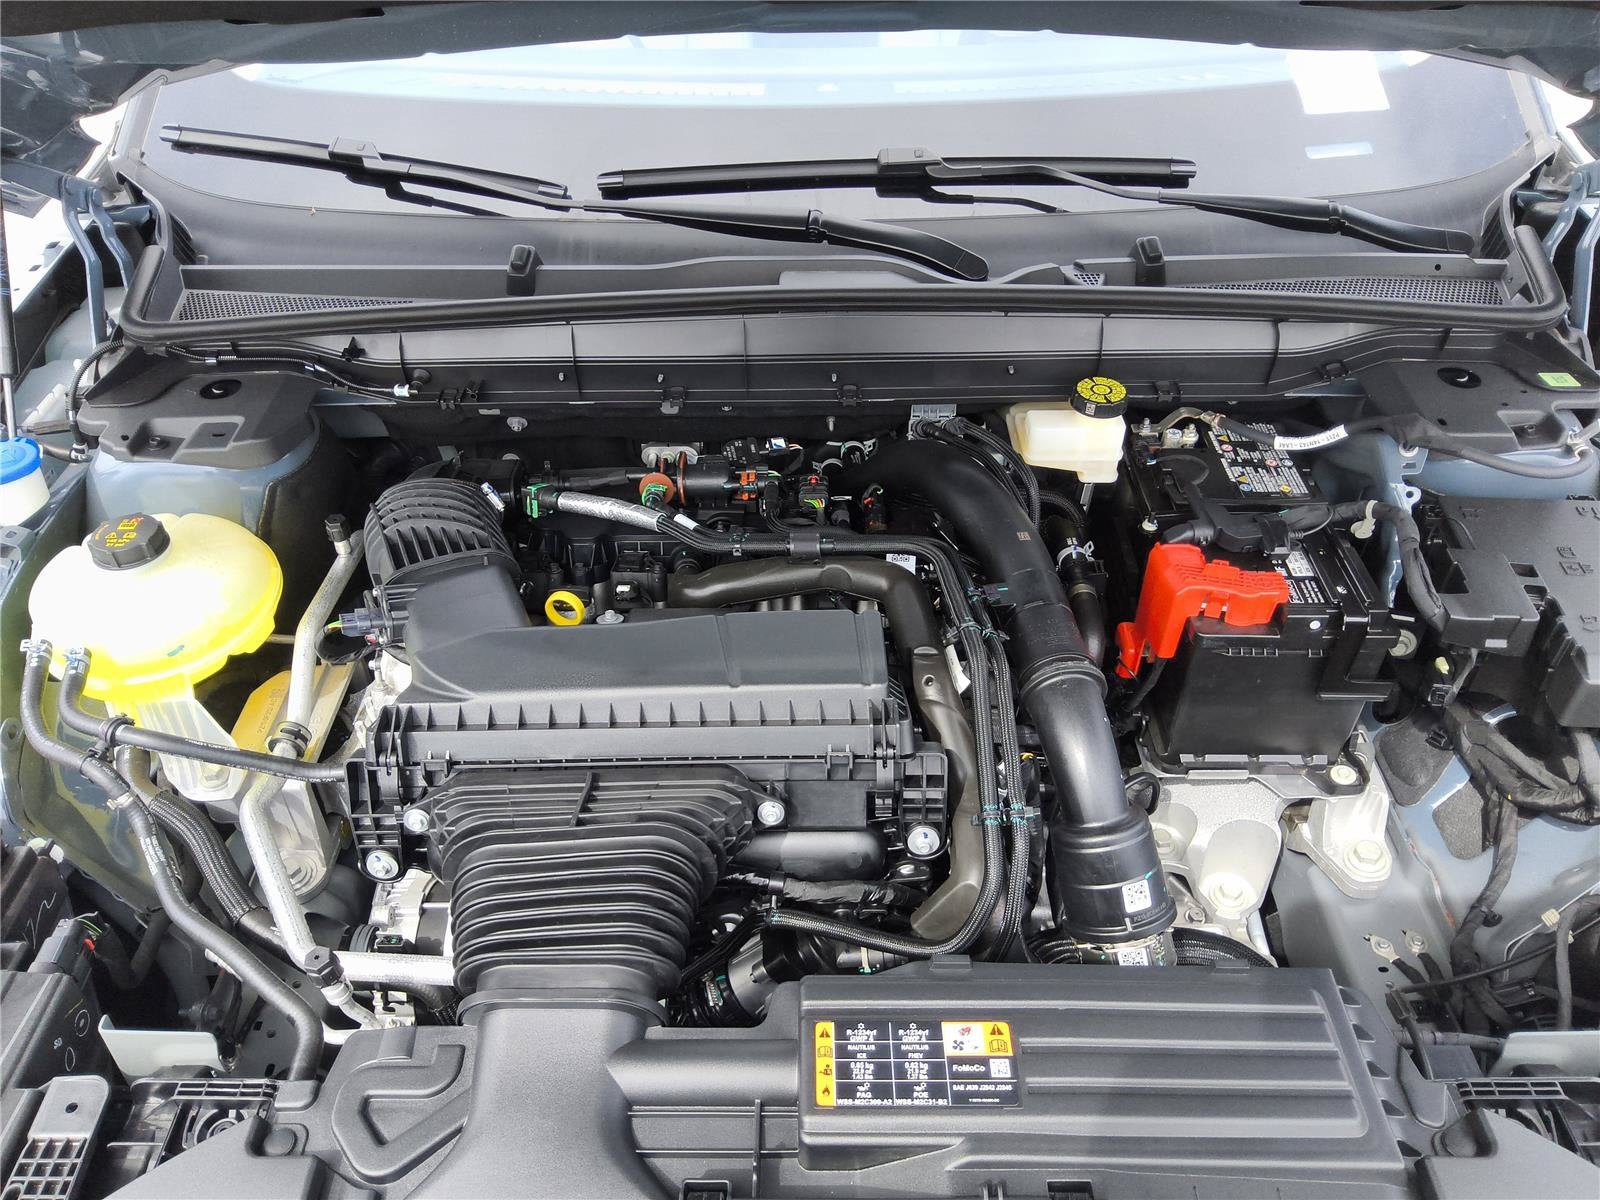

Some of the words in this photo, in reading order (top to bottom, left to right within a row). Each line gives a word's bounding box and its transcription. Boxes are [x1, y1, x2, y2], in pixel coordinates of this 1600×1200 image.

[846, 1029, 877, 1037] R-1234yf
[898, 1029, 929, 1037] R-1234yf
[865, 1062, 874, 1070] kg
[920, 1062, 928, 1070] kg
[952, 1064, 986, 1072] FoMoCo
